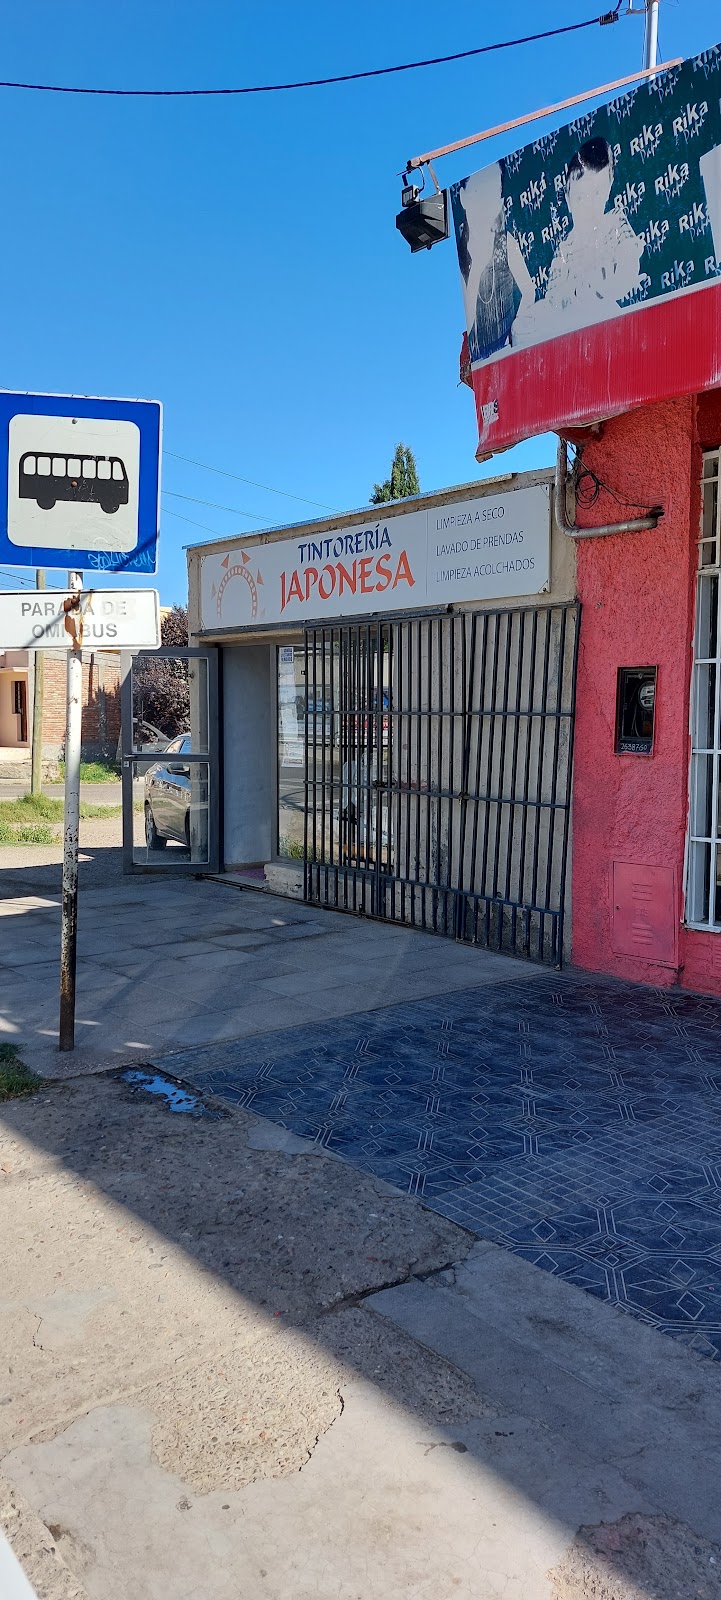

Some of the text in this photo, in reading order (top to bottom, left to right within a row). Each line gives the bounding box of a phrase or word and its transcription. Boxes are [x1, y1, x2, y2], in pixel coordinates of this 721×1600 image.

[436, 506, 505, 531] LIMPIEZA A SECO
[297, 523, 393, 564] TINTORERÍA
[436, 530, 524, 557] LAVADO DE PRENDAS
[279, 549, 417, 615] JAPONESA
[436, 557, 535, 583] LIMPIEZA ACOLCHADOS
[102, 600, 127, 616] DE
